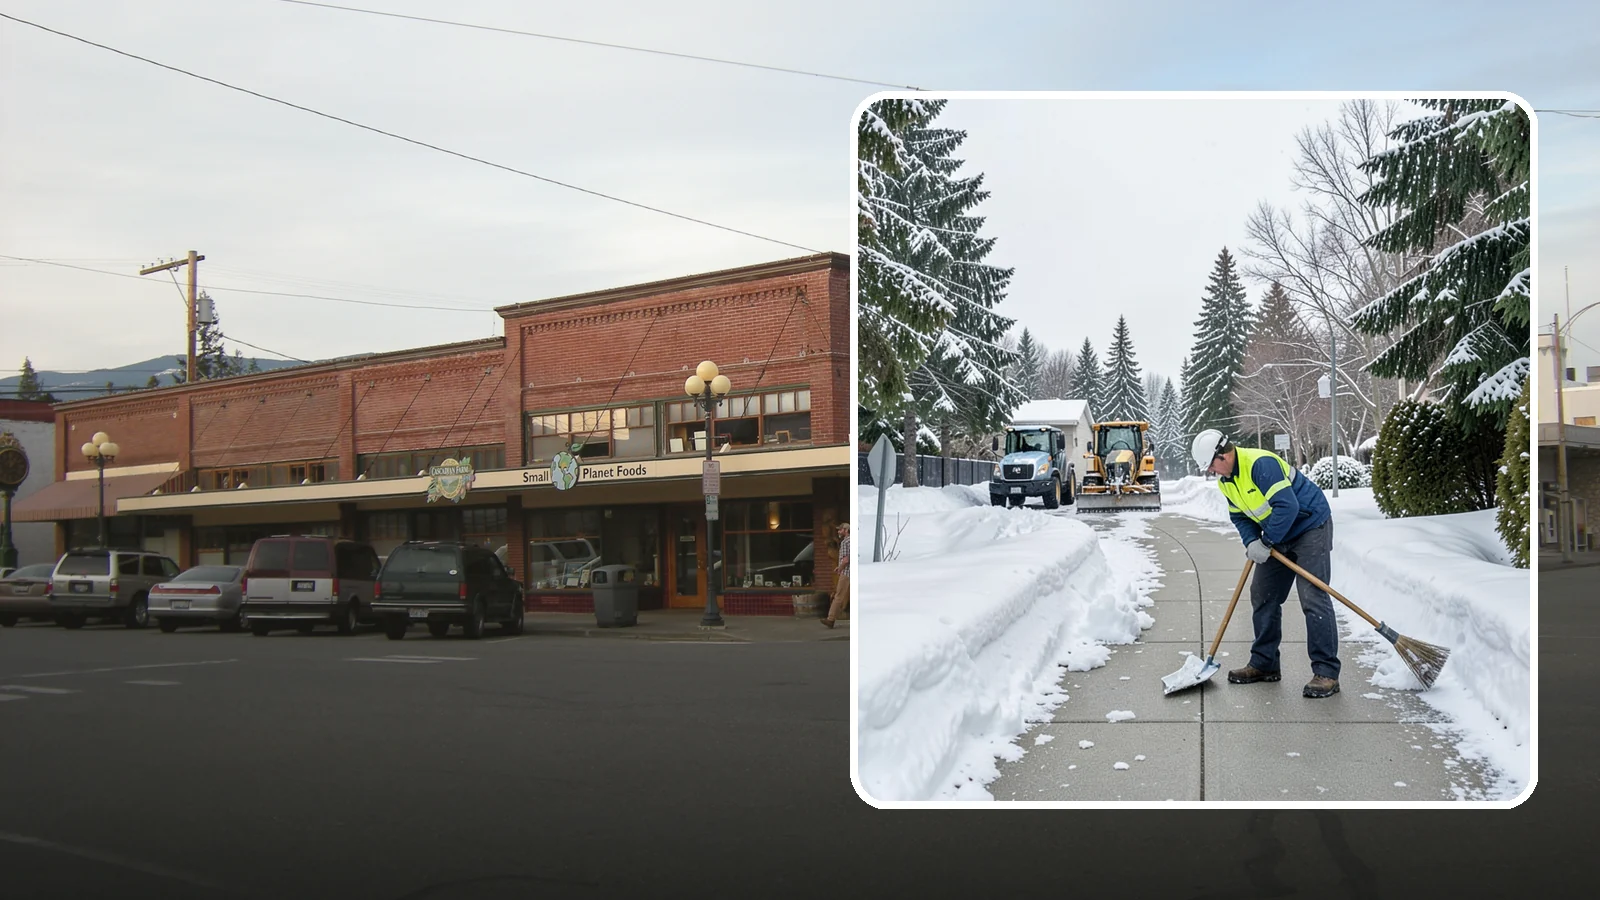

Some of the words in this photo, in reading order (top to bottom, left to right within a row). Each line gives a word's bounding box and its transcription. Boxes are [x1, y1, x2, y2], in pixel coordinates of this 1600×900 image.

[523, 471, 549, 483] Small
[582, 467, 614, 479] Planet
[617, 464, 647, 477] Foods
